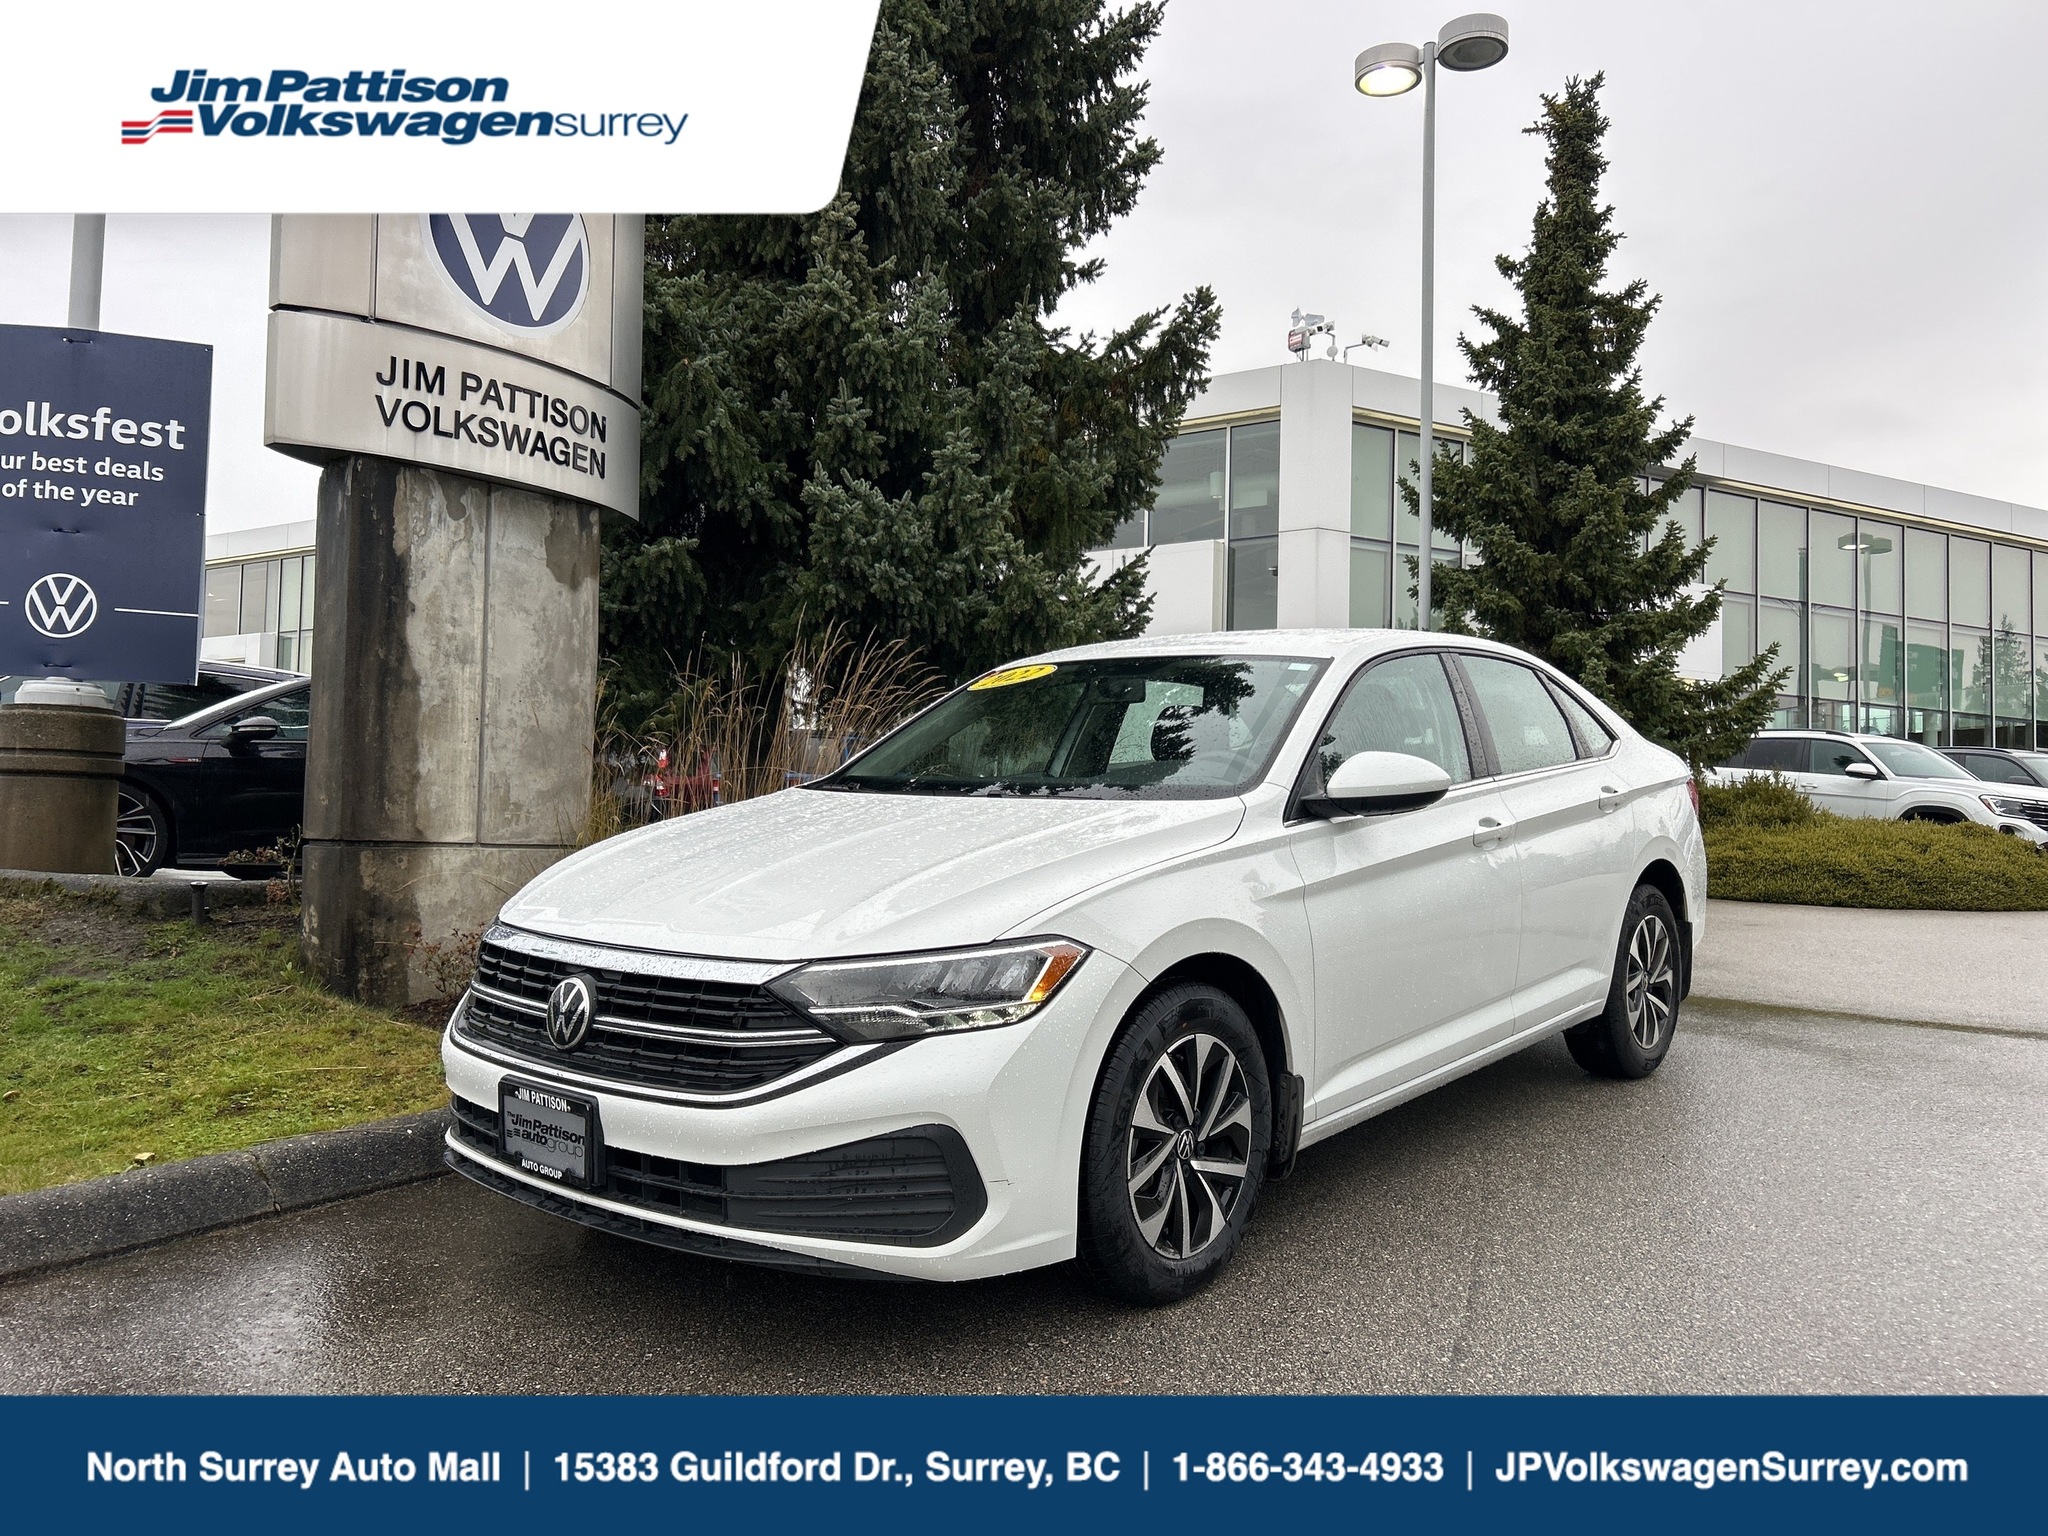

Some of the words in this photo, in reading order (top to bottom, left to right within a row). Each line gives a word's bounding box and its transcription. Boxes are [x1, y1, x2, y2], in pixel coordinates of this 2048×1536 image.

[376, 356, 446, 396] JIM
[460, 371, 607, 443] PATTISON
[375, 395, 606, 479] VOLKSWAGEN
[32, 451, 88, 474] best
[94, 456, 165, 482] deals
[1, 478, 28, 498] of
[32, 480, 75, 501] the
[80, 486, 139, 507] year
[518, 1087, 530, 1102] JIM
[531, 1091, 567, 1112] PATTISON
[521, 1158, 538, 1172] AUTO
[539, 1164, 562, 1180] GROUP
